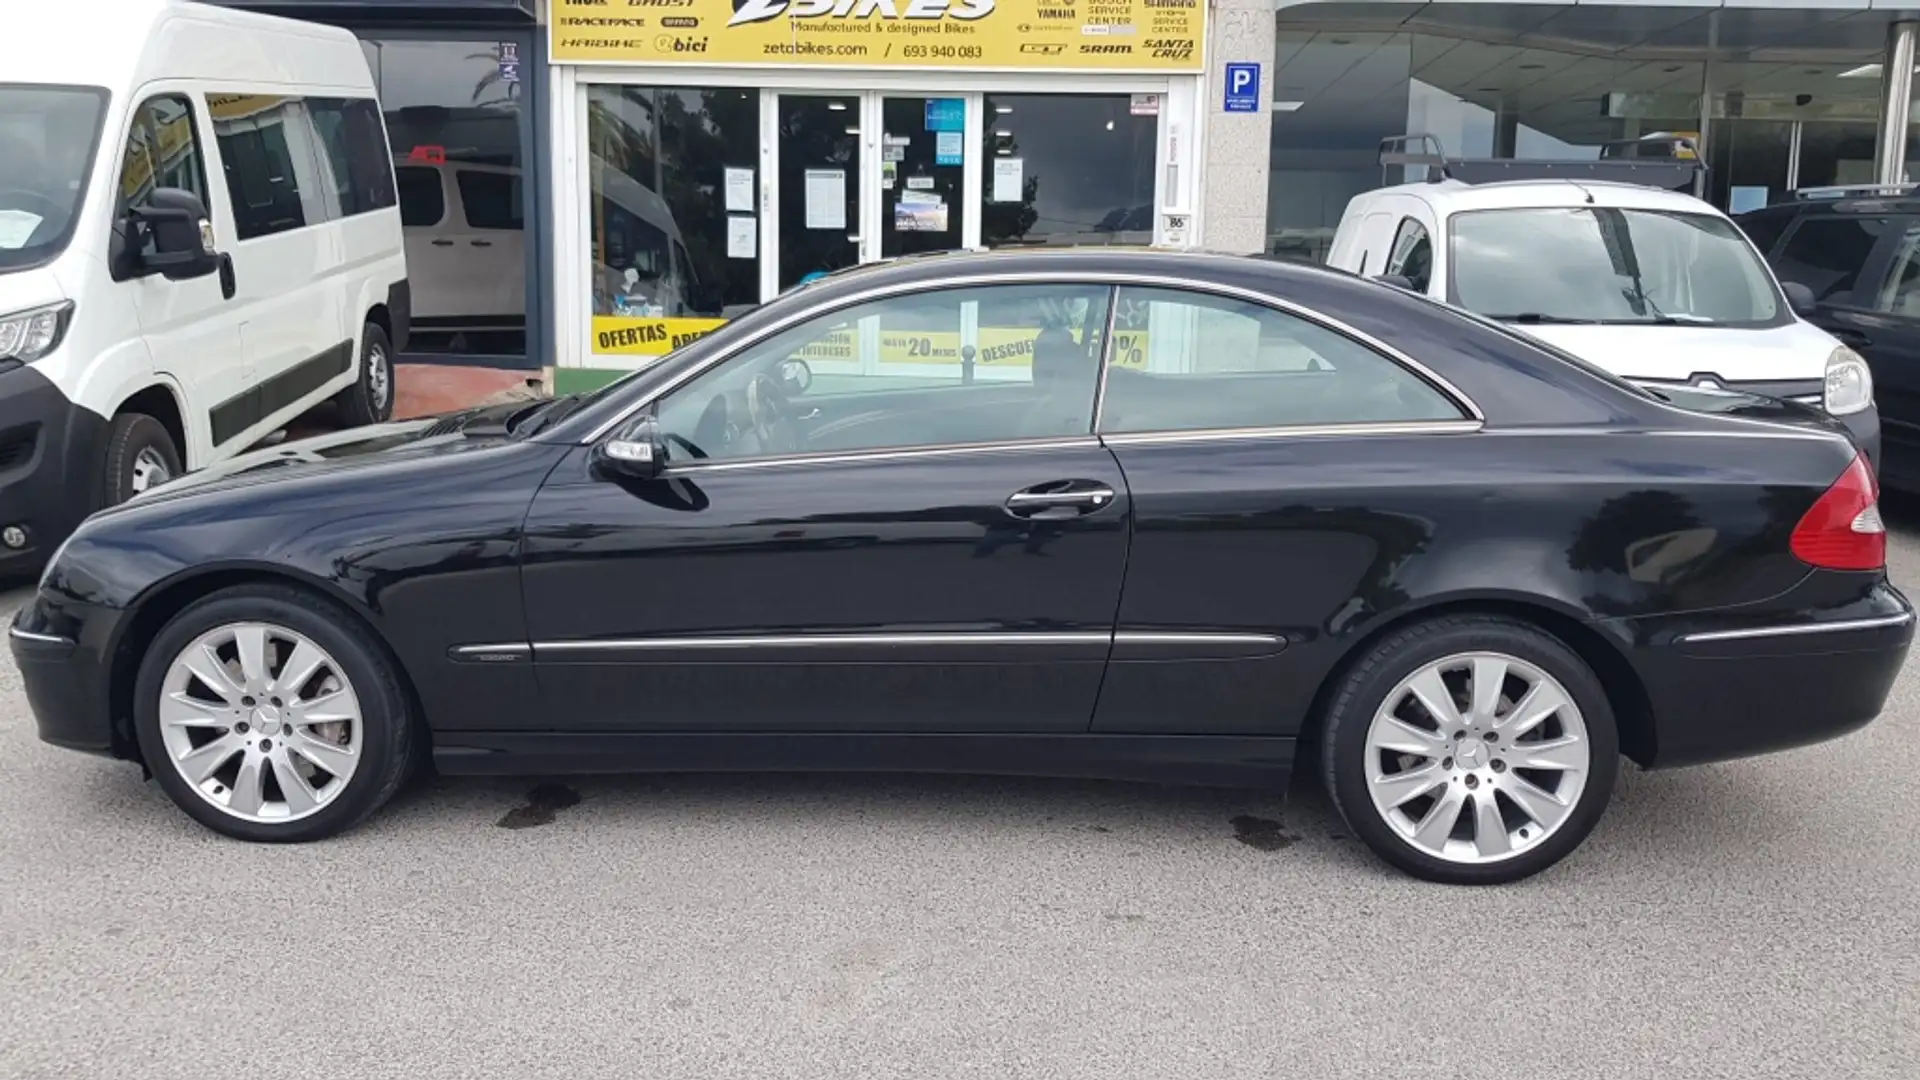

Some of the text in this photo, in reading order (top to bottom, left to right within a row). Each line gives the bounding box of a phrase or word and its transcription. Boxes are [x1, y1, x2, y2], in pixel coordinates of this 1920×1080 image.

[1036, 8, 1076, 19] YAMAHA
[1087, 6, 1131, 14] SERVICE
[1087, 17, 1131, 25] CENTER
[791, 21, 976, 37] Manufactured & designed Bikes
[1079, 45, 1132, 54] SRAM
[1142, 40, 1194, 48] SANTA
[763, 43, 868, 56] zetabikes.com
[902, 45, 928, 58] 693
[930, 45, 956, 58] 940
[957, 45, 983, 59] 083
[1152, 49, 1194, 58] CRUZ
[1234, 70, 1250, 94] P
[598, 323, 668, 349] OFERTAS
[907, 337, 932, 358] 20
[982, 339, 1034, 363] DESCUE
